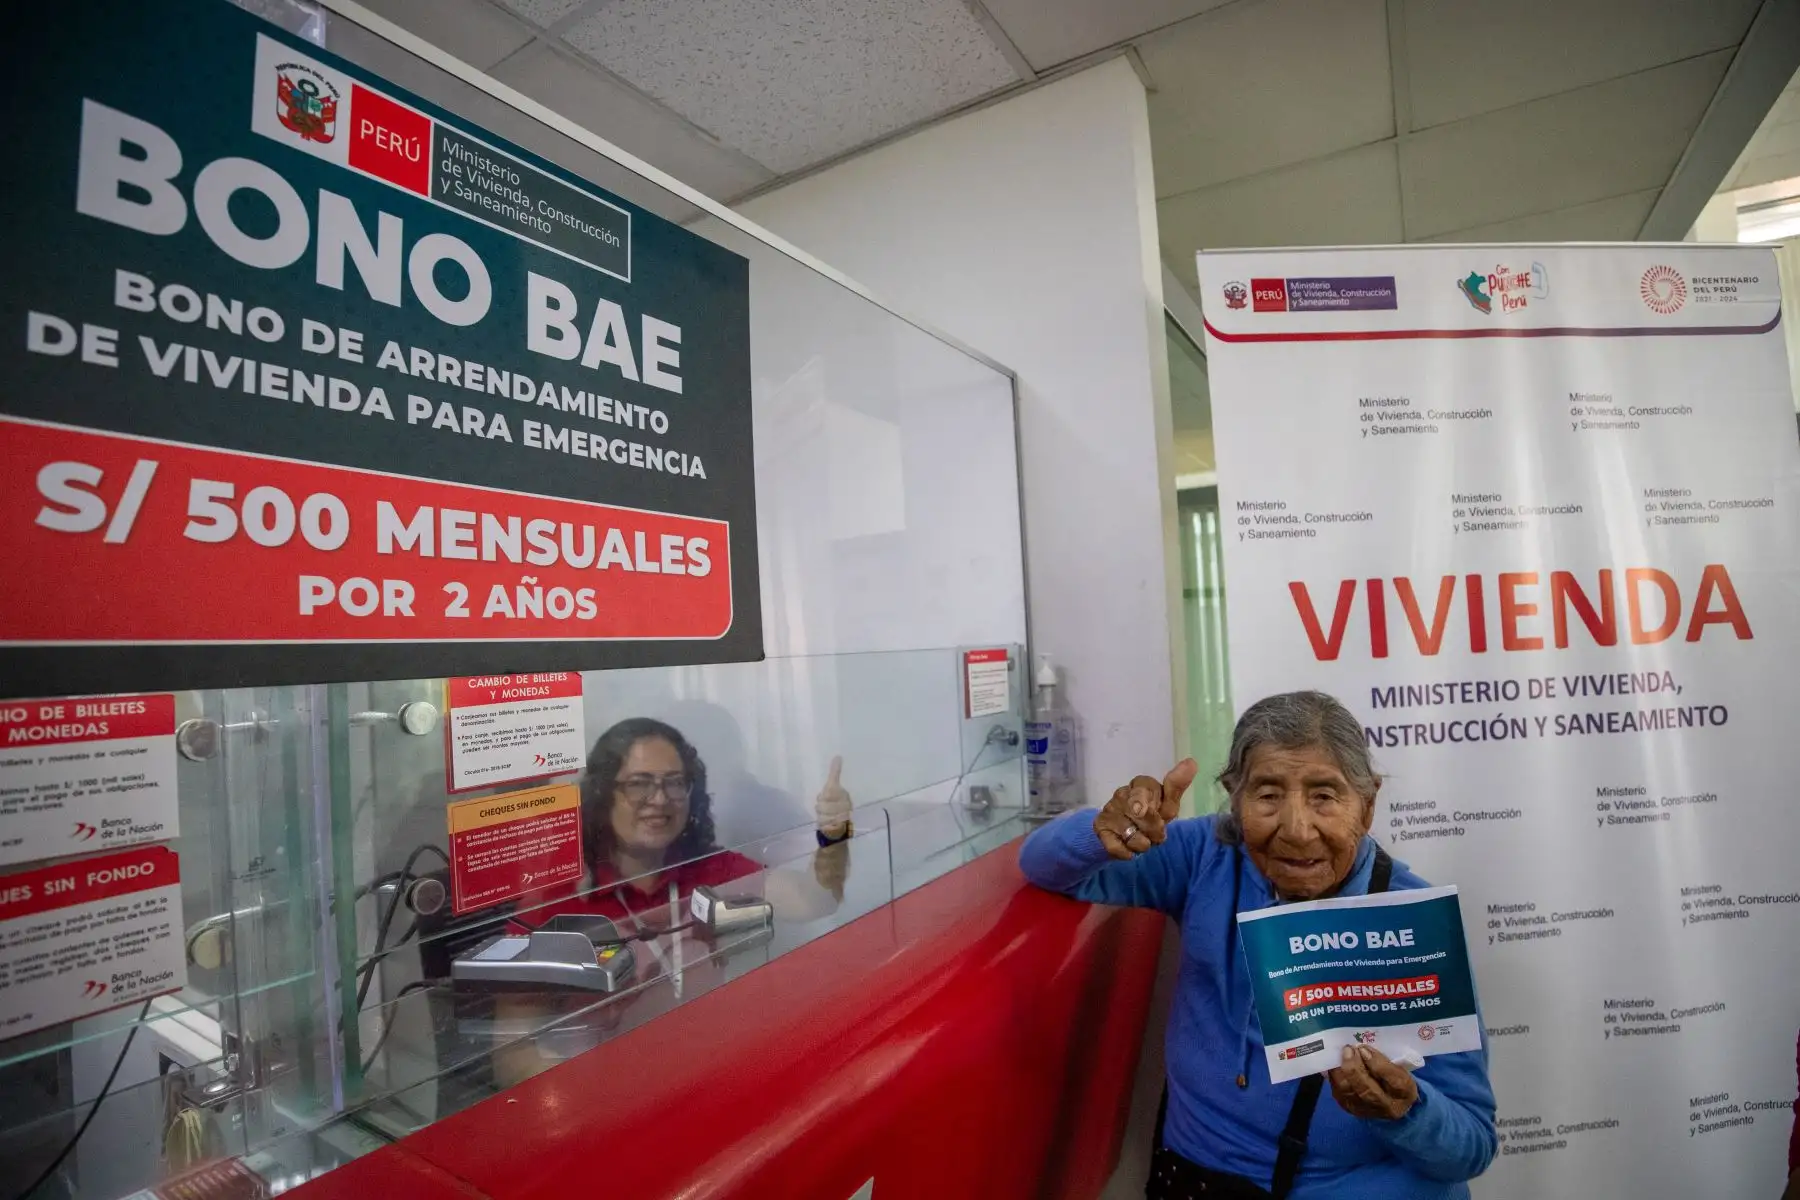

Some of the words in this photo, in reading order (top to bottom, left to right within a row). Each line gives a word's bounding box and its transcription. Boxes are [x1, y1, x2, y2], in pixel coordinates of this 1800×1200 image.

[360, 119, 420, 162] PERÚ
[443, 137, 520, 185] Ministerio
[441, 177, 450, 194] y
[454, 181, 551, 234] Saneamiento
[442, 157, 462, 177] de
[466, 166, 534, 212] Vivienda,
[538, 200, 620, 248] Construcción
[76, 98, 493, 326] BONO
[527, 271, 683, 394] BAE
[1290, 281, 1331, 290] Ministerio
[1692, 276, 1759, 284] BICENTENARIO
[1255, 289, 1283, 301] PERÚ
[1291, 290, 1301, 298] de
[1341, 288, 1392, 297] Construcción
[1713, 285, 1737, 293] PERÚ
[1299, 298, 1350, 306] Saneamiento
[1502, 294, 1527, 311] Perú
[114, 268, 285, 342] BONO
[301, 319, 364, 363] DE
[376, 340, 669, 435] ARRENDAMIENTO
[27, 311, 118, 368] DE
[139, 335, 394, 422] VIVIENDA
[407, 394, 512, 443] PARA
[523, 419, 707, 480] EMERGENCIA
[1359, 396, 1410, 407] Ministerio
[1360, 412, 1374, 421] de
[1377, 410, 1425, 421] Vivienda,
[1427, 407, 1493, 420] Construcción
[1570, 407, 1583, 416] de
[1628, 404, 1693, 416] Construcción
[1361, 428, 1368, 438] y
[1371, 423, 1439, 435] Saneamiento
[1571, 422, 1578, 432] y
[1451, 493, 1502, 503] Ministerio
[1644, 488, 1692, 498] Ministerio
[1236, 500, 1287, 511] Ministerio
[1452, 508, 1465, 518] de
[1468, 506, 1516, 517] Vivienda,
[1644, 502, 1657, 512] de
[1708, 498, 1774, 510] Construcción
[34, 458, 159, 544] S/
[184, 476, 349, 551] 500
[376, 500, 712, 577] MENSUALES
[1237, 515, 1251, 525] de
[1253, 513, 1301, 525] Vivienda,
[1304, 511, 1373, 523] Construcción
[1654, 514, 1720, 525] Saneamiento
[1238, 531, 1245, 541] y
[1248, 528, 1316, 539] Saneamiento
[298, 575, 415, 617] POR
[443, 582, 470, 617] 2
[482, 574, 598, 620] AÑOS
[1288, 563, 1755, 661] VIVIENDA
[468, 676, 511, 688] CAMBIO
[516, 675, 528, 684] DE
[533, 672, 568, 683] BILLETES
[489, 690, 496, 700] Y
[502, 686, 550, 698] MONEDAS
[1371, 679, 1520, 709] MINISTERIO
[1528, 677, 1556, 699] DE
[1563, 670, 1683, 697] VIVIENDA,
[40, 706, 65, 720] DE
[76, 701, 146, 718] BILLETES
[8, 721, 110, 742] MONEDAS
[1364, 713, 1528, 748] NSTRUCCIÓN
[1535, 716, 1548, 737] Y
[1554, 704, 1729, 736] SANEAMIENTO
[1596, 786, 1646, 797] Ministerio
[480, 805, 515, 818] CHEQUES
[530, 796, 556, 807] FONDO
[1390, 800, 1436, 812] Ministerio
[1597, 801, 1610, 811] de
[101, 817, 132, 829] Banco
[1390, 817, 1403, 827] de
[1405, 813, 1450, 826] Vivienda,
[1453, 808, 1522, 821] Construcción
[1597, 817, 1604, 828] y
[1607, 812, 1671, 825] Saneamiento
[101, 829, 114, 839] de
[116, 827, 126, 837] la
[129, 823, 164, 835] Nación
[1400, 826, 1465, 841] Saneamiento
[44, 876, 75, 895] SIN
[87, 862, 155, 886] FONDO
[1680, 884, 1722, 896] Ministerio
[1487, 901, 1536, 914] Ministerio
[1681, 901, 1691, 911] de
[1738, 892, 1800, 905] Construcció
[1487, 919, 1501, 929] de
[1550, 908, 1614, 922] Construcción
[1689, 909, 1750, 924] Saneamiento
[1288, 931, 1359, 954] BONO
[1365, 928, 1415, 949] BAE
[1497, 927, 1562, 942] Saneamiento
[1268, 970, 1284, 979] Bono
[1293, 960, 1343, 972] Arrendamiento
[1344, 959, 1353, 967] de
[1354, 958, 1385, 966] Vivienda
[1386, 958, 1403, 967] para
[1404, 950, 1446, 965] Emergencias
[111, 969, 142, 983] Banco
[112, 984, 124, 994] de
[127, 980, 137, 991] la
[139, 971, 174, 986] Nación
[1288, 989, 1302, 1007] S/
[1306, 986, 1334, 1001] 500
[1338, 979, 1436, 997] MENSUALES
[1288, 1012, 1309, 1024] POR
[1310, 1006, 1325, 1017] UN
[1327, 1003, 1379, 1014] PERIODO
[1381, 1002, 1398, 1012] DE
[1399, 1001, 1407, 1010] 2
[1409, 997, 1441, 1009] AÑOS
[1603, 997, 1654, 1009] Ministerio
[1604, 1014, 1617, 1024] de
[1670, 1001, 1726, 1020] Construcción
[1613, 1023, 1681, 1036] Saneamiento
[1689, 1091, 1729, 1108] Ministerio
[1690, 1112, 1701, 1121] de
[1703, 1104, 1741, 1119] Vivienda,
[1744, 1100, 1794, 1111] Construcc
[1556, 1118, 1619, 1135] Construcción
[1698, 1116, 1754, 1134] Saneamiento
[1502, 1140, 1567, 1155] Saneamiento
